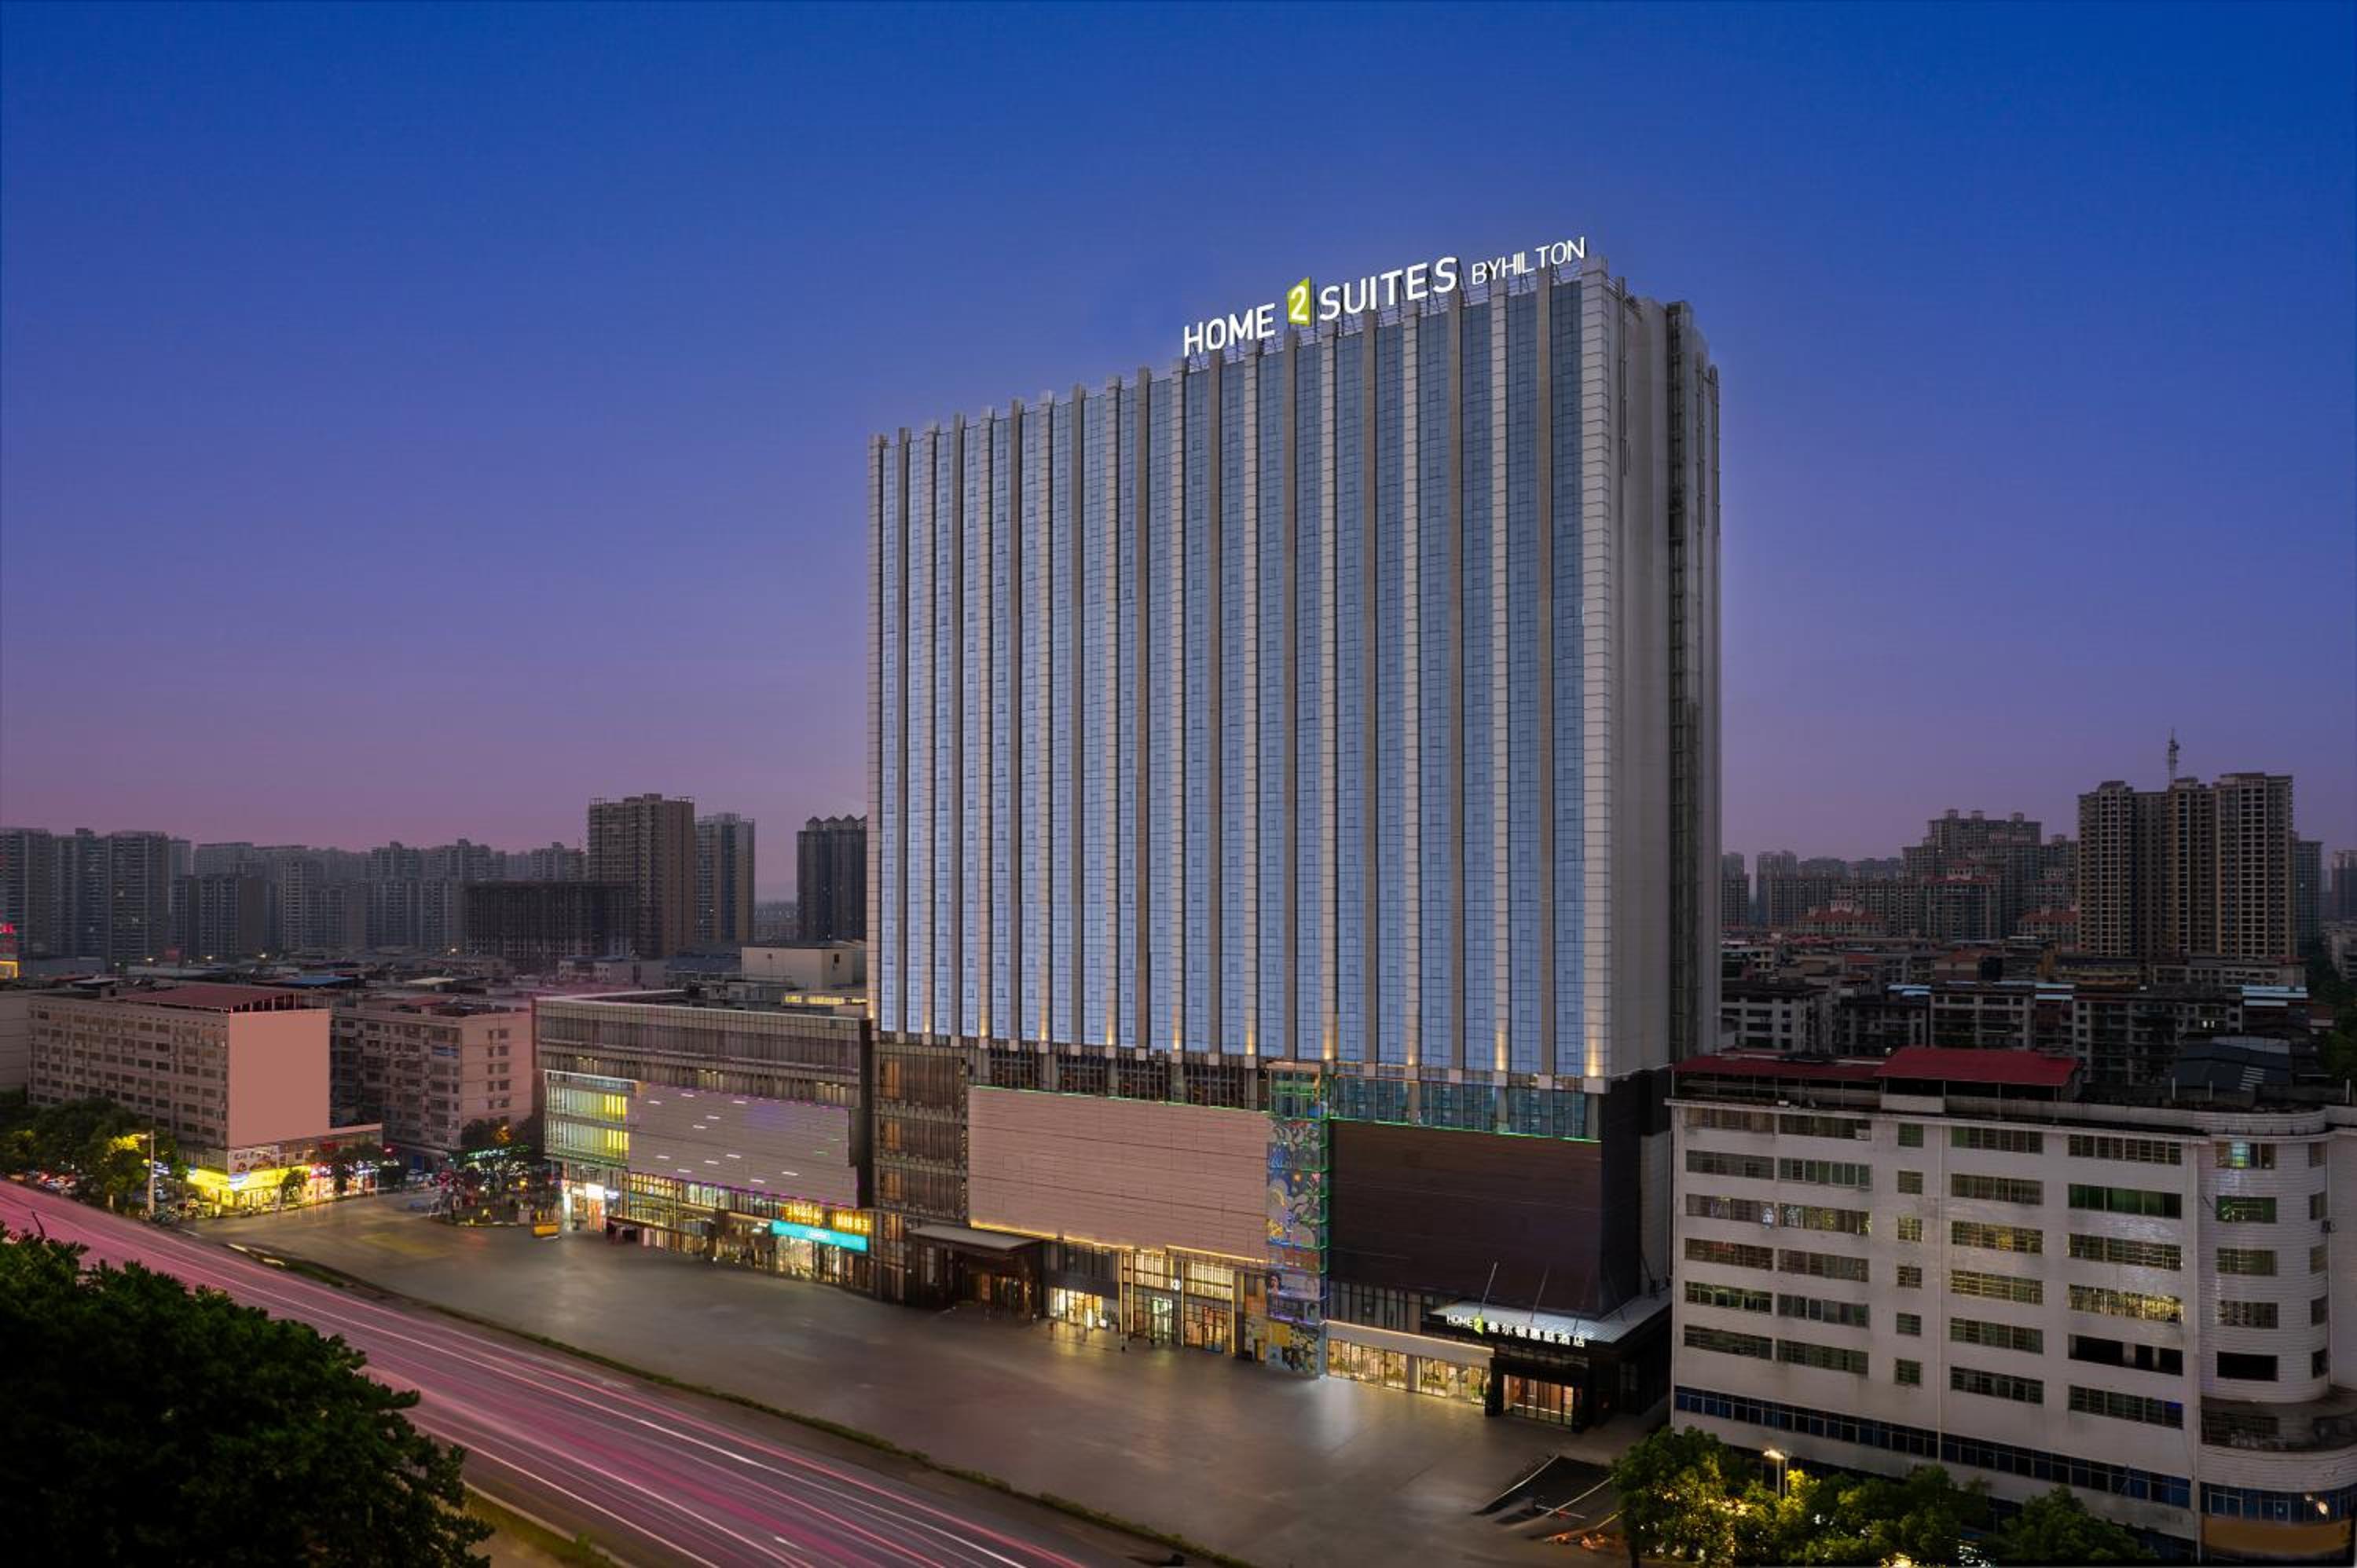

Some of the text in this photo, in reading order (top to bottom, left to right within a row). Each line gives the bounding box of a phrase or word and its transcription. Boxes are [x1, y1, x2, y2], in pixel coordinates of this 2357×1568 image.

[1184, 303, 1275, 357] HOME
[1290, 286, 1308, 321] 2
[1319, 257, 1457, 321] SUITES
